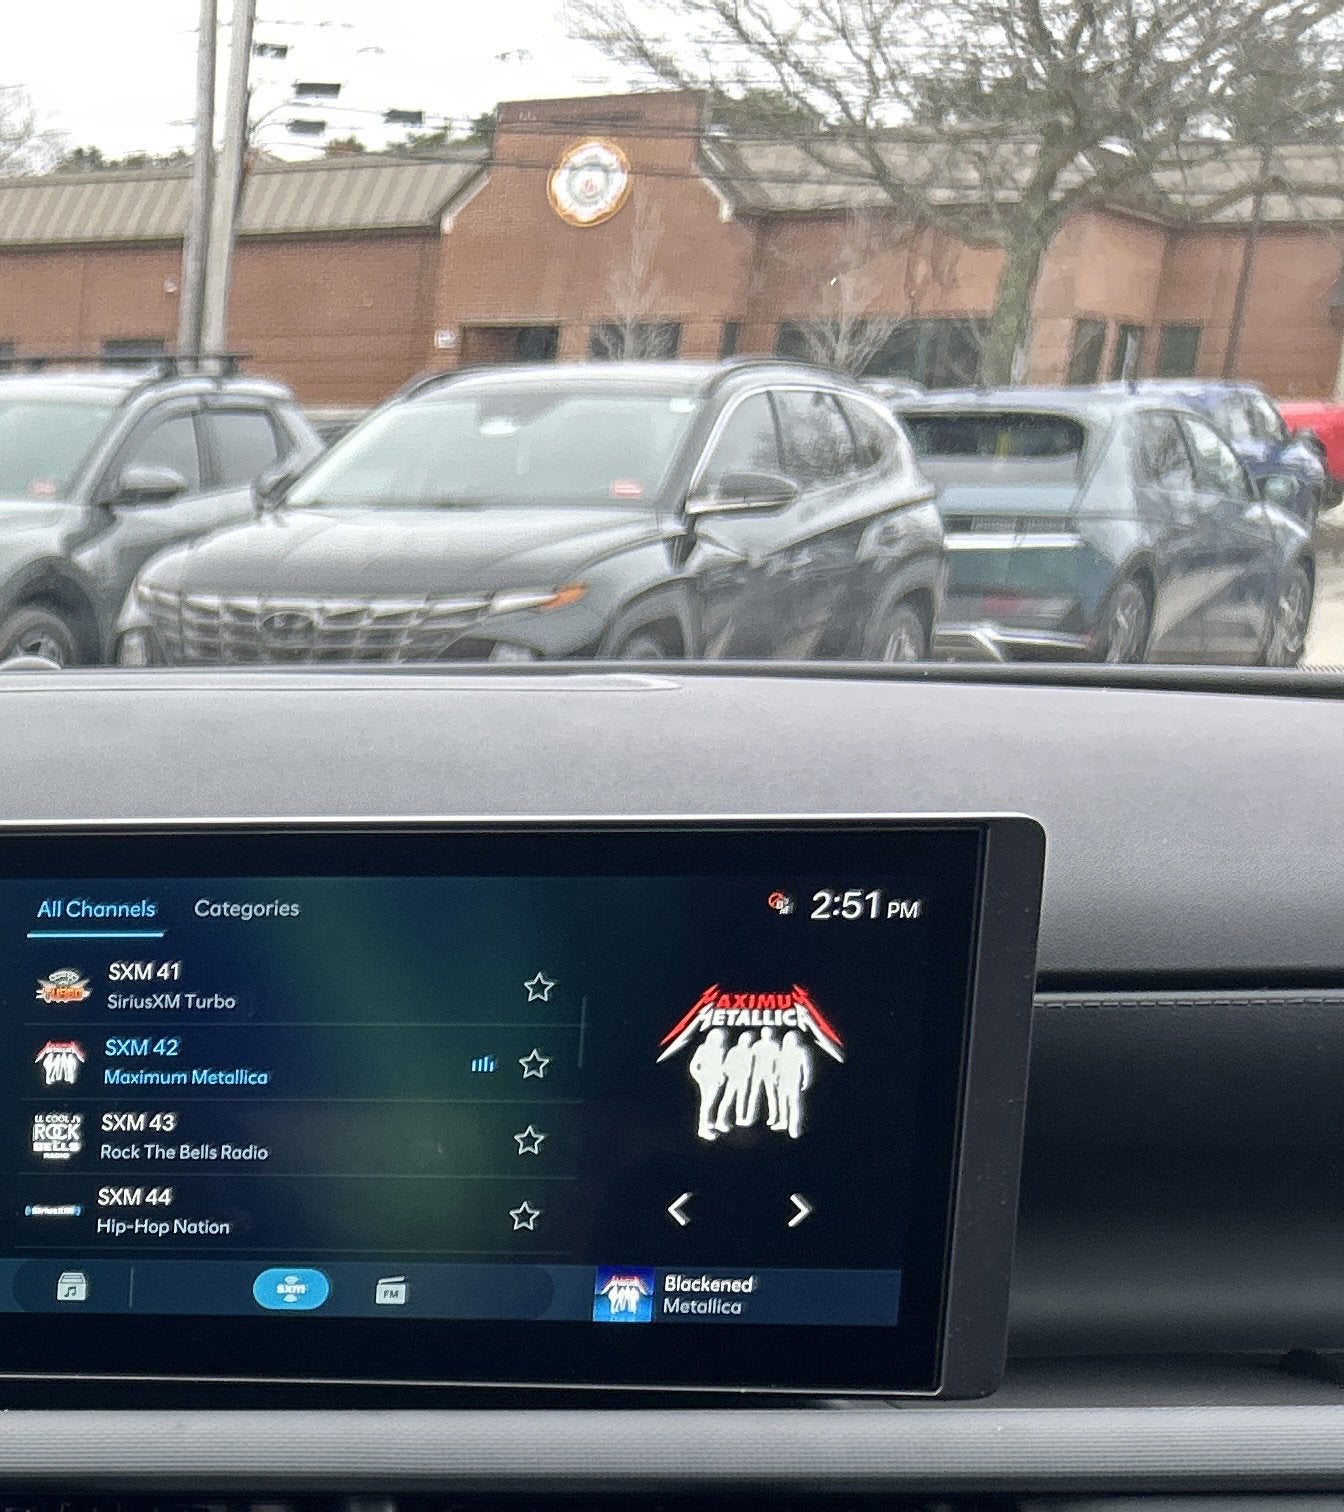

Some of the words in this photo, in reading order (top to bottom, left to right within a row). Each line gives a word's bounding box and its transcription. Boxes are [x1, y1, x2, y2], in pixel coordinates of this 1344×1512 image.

[37, 899, 61, 919] All
[65, 899, 156, 919] Channels
[194, 899, 300, 920] Categories
[811, 889, 882, 919] 2:51
[887, 899, 920, 919] PM
[108, 962, 152, 982] SXM
[156, 962, 180, 982] 41
[107, 994, 180, 1010] SiriusXM
[184, 994, 236, 1010] Turbo
[104, 1038, 149, 1057] SXM
[153, 1038, 178, 1057] 42
[103, 1069, 187, 1086] Maximum
[191, 1069, 268, 1086] Metallica
[101, 1113, 146, 1132] SXM
[149, 1113, 175, 1132] 43
[33, 1124, 80, 1140] ROCK
[100, 1144, 139, 1160] Rock
[143, 1144, 175, 1160] The
[179, 1144, 217, 1160] Bells
[220, 1144, 268, 1160] Radio
[97, 1187, 142, 1207] SXM
[145, 1187, 172, 1207] 44
[97, 1219, 169, 1236] Hip-Hop
[173, 1219, 230, 1235] Nation
[664, 1275, 753, 1293] Blackened
[664, 1298, 742, 1315] Metallica
